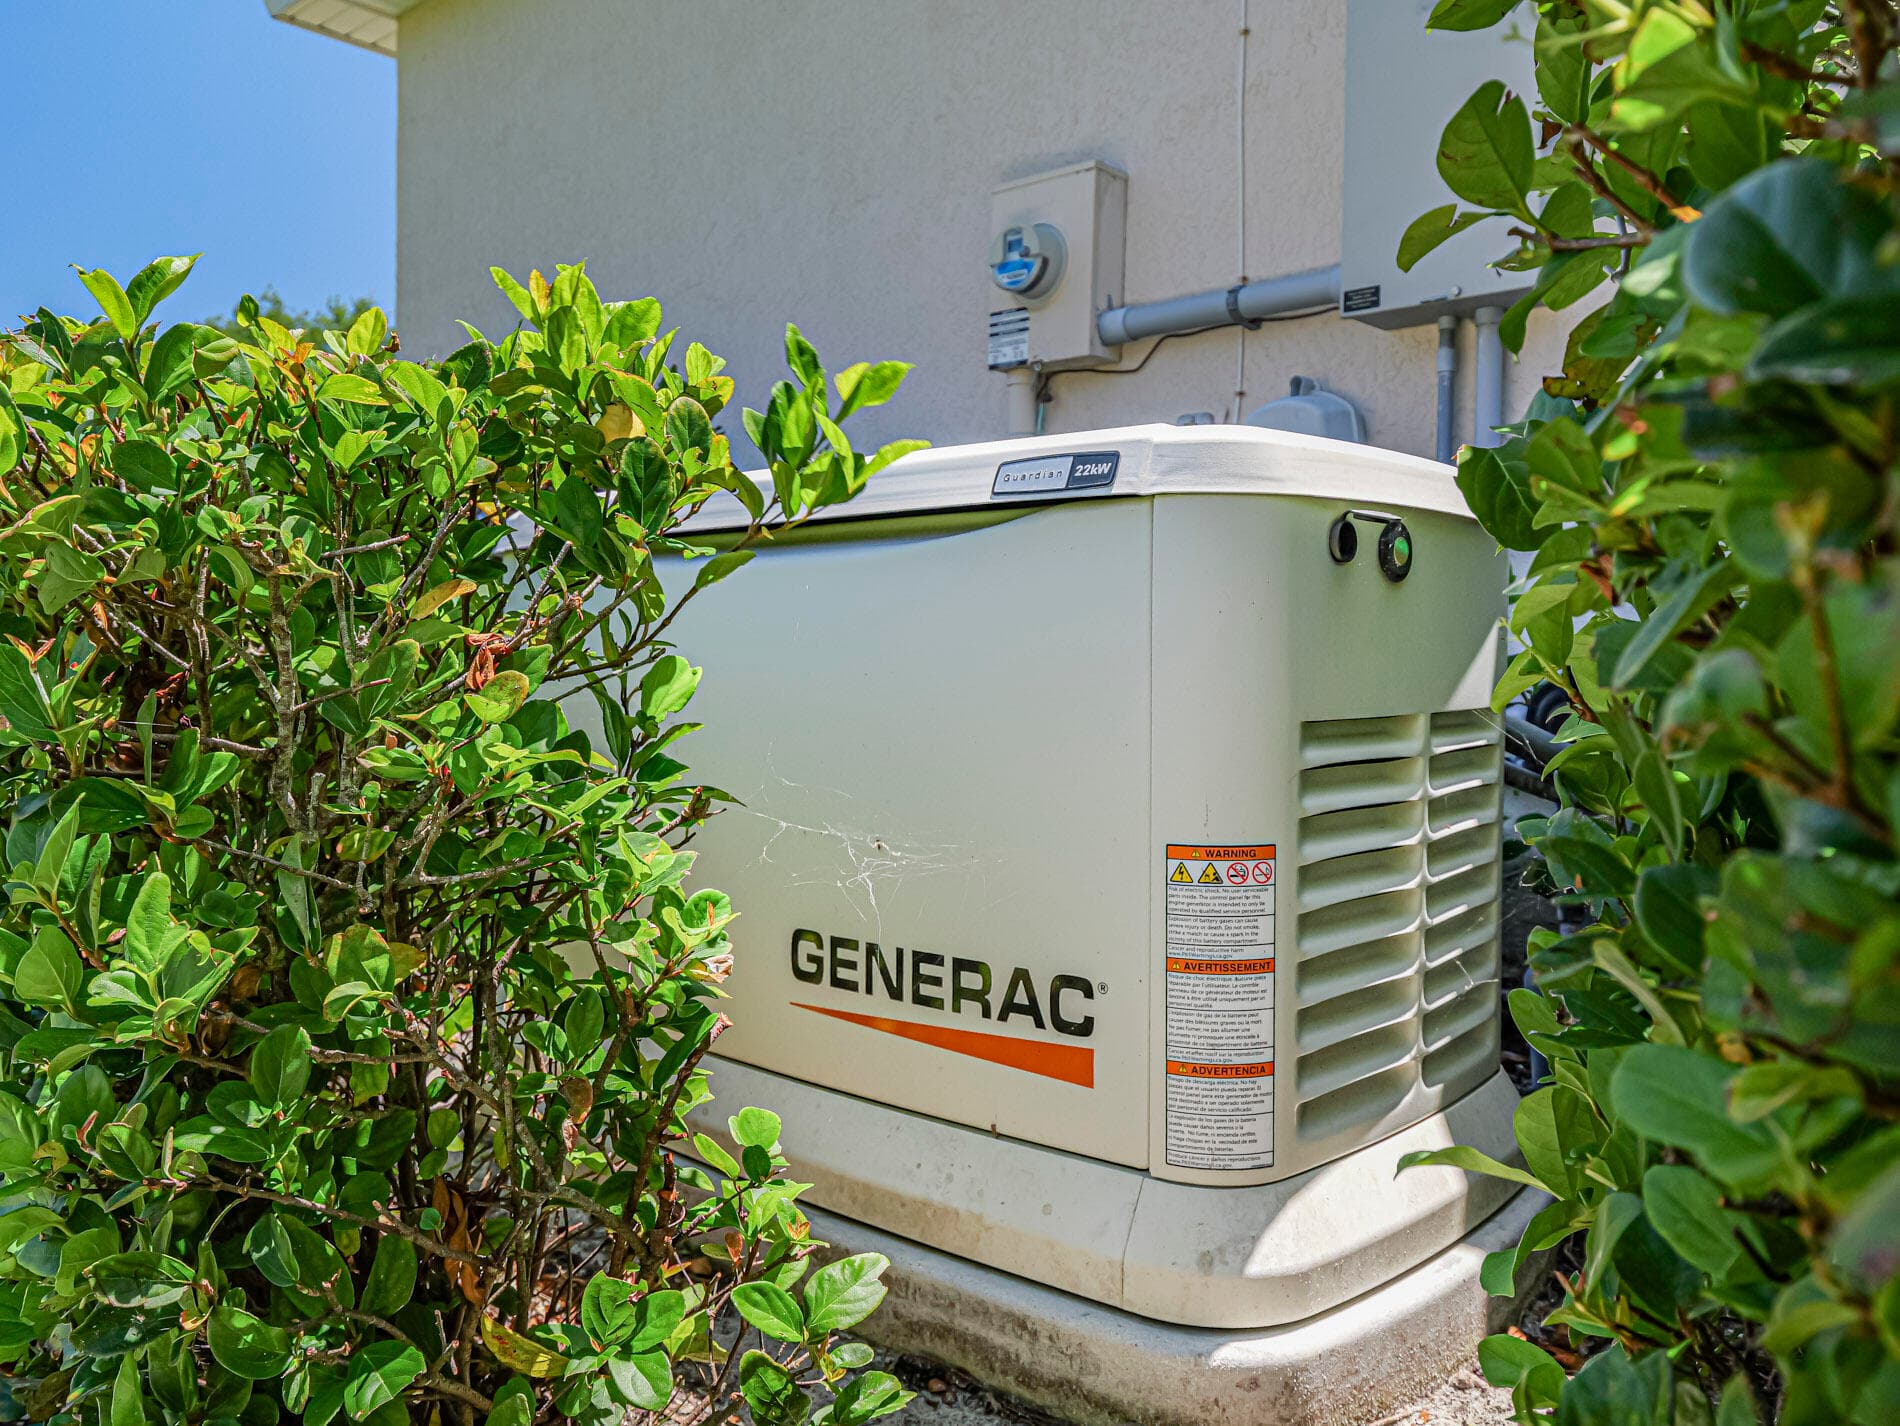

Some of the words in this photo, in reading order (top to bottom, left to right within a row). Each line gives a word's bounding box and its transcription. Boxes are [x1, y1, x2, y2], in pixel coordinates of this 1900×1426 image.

[1003, 470, 1063, 482] Guardian
[1074, 462, 1111, 476] 22kW
[1206, 850, 1256, 858] WARNING
[1184, 962, 1271, 972] AVERTISSEMENT
[1192, 1066, 1266, 1075] ADVERTENCIA
